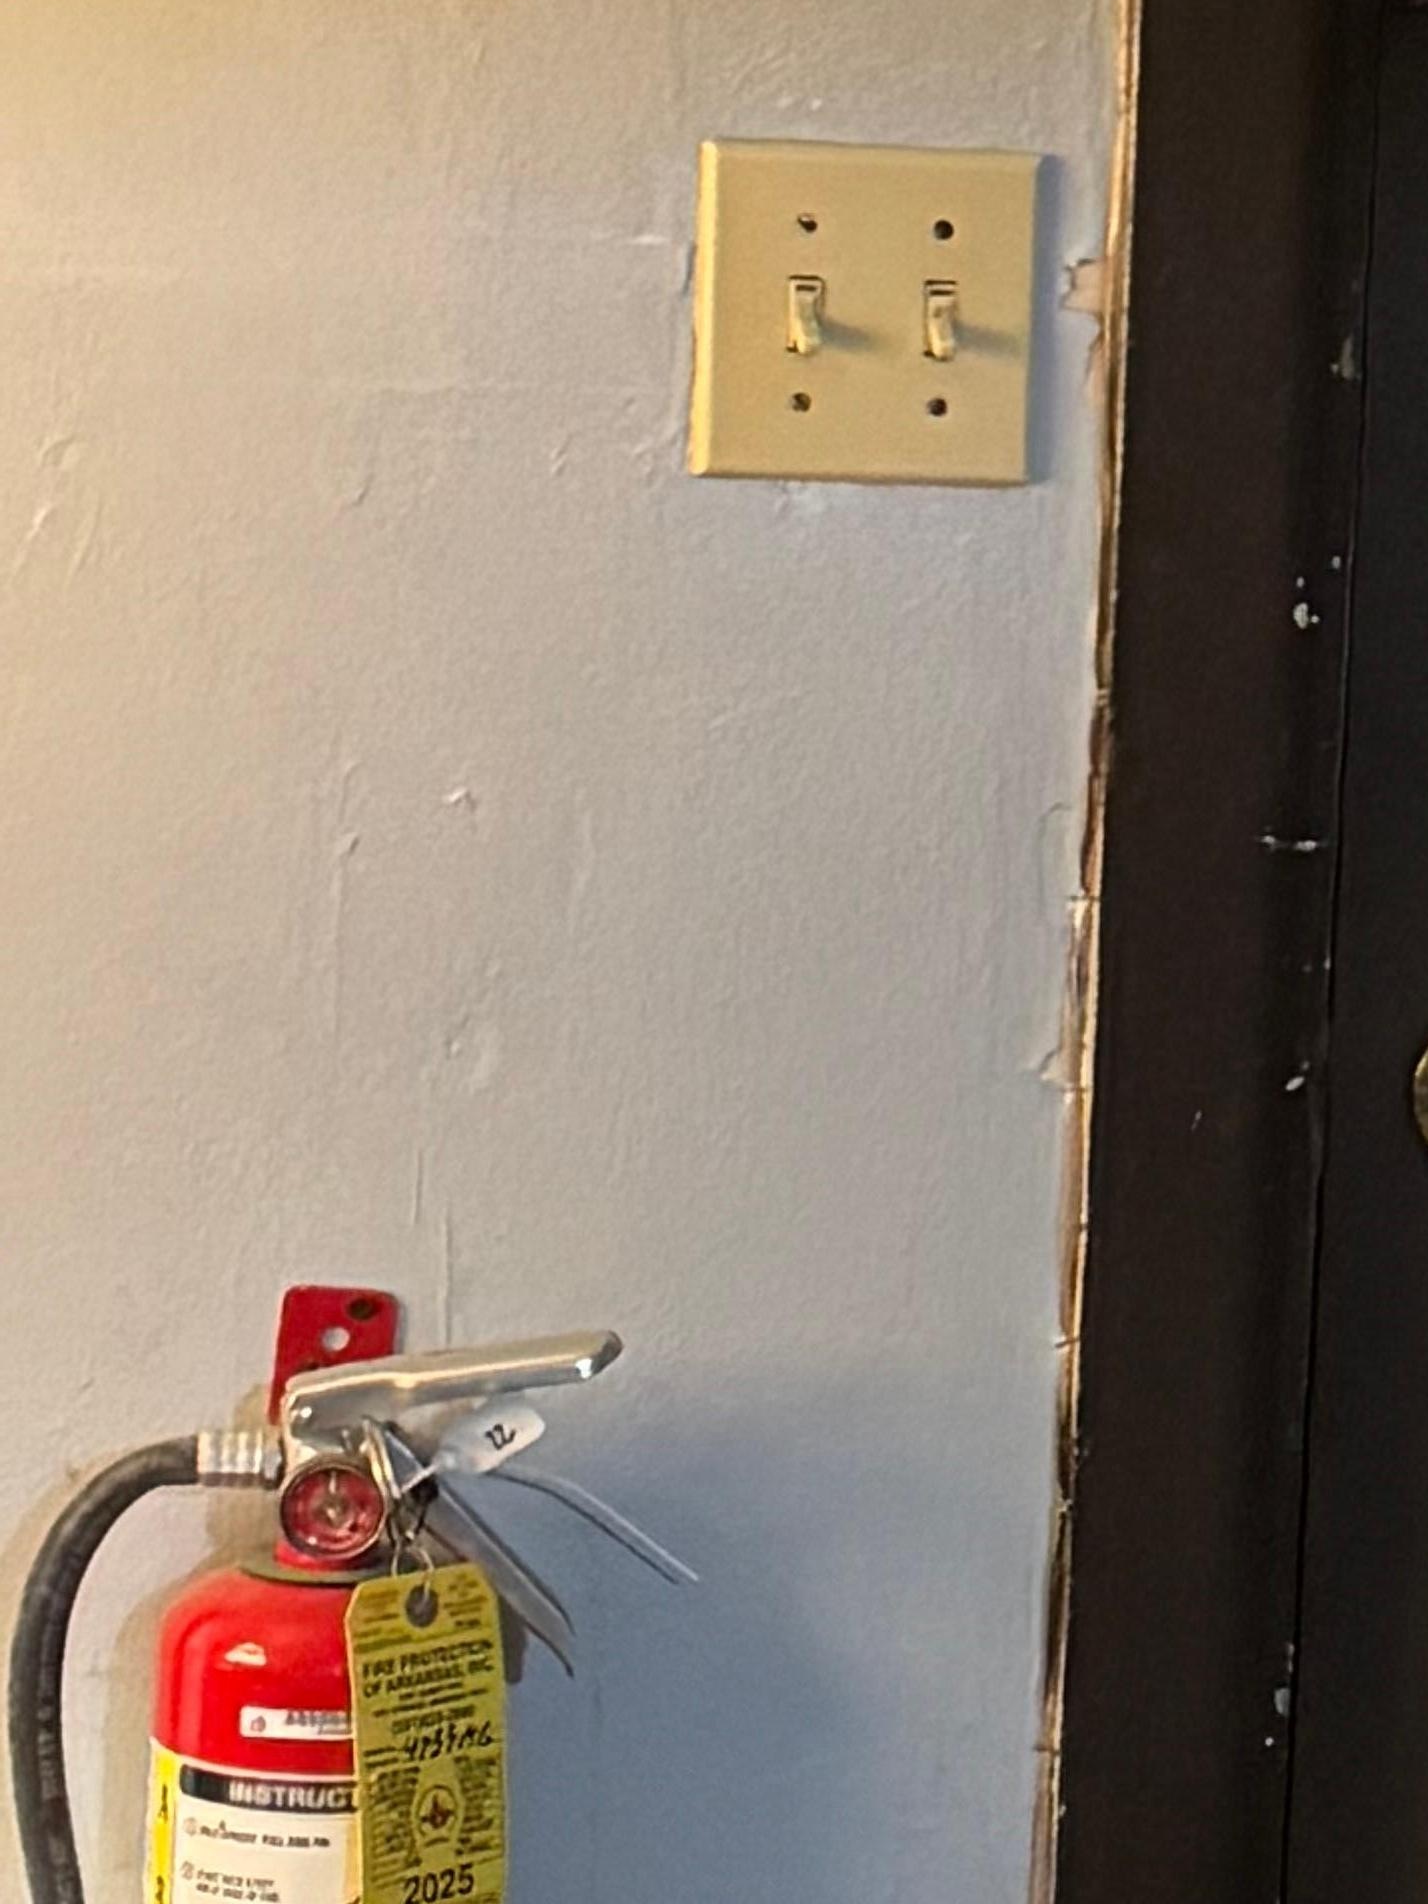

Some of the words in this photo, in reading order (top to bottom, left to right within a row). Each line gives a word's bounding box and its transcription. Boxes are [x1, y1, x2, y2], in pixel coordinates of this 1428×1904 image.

[362, 1658, 396, 1680] FIRE
[400, 1639, 494, 1670] PROTECTION
[363, 1680, 382, 1698] OF
[158, 1783, 169, 1823] A
